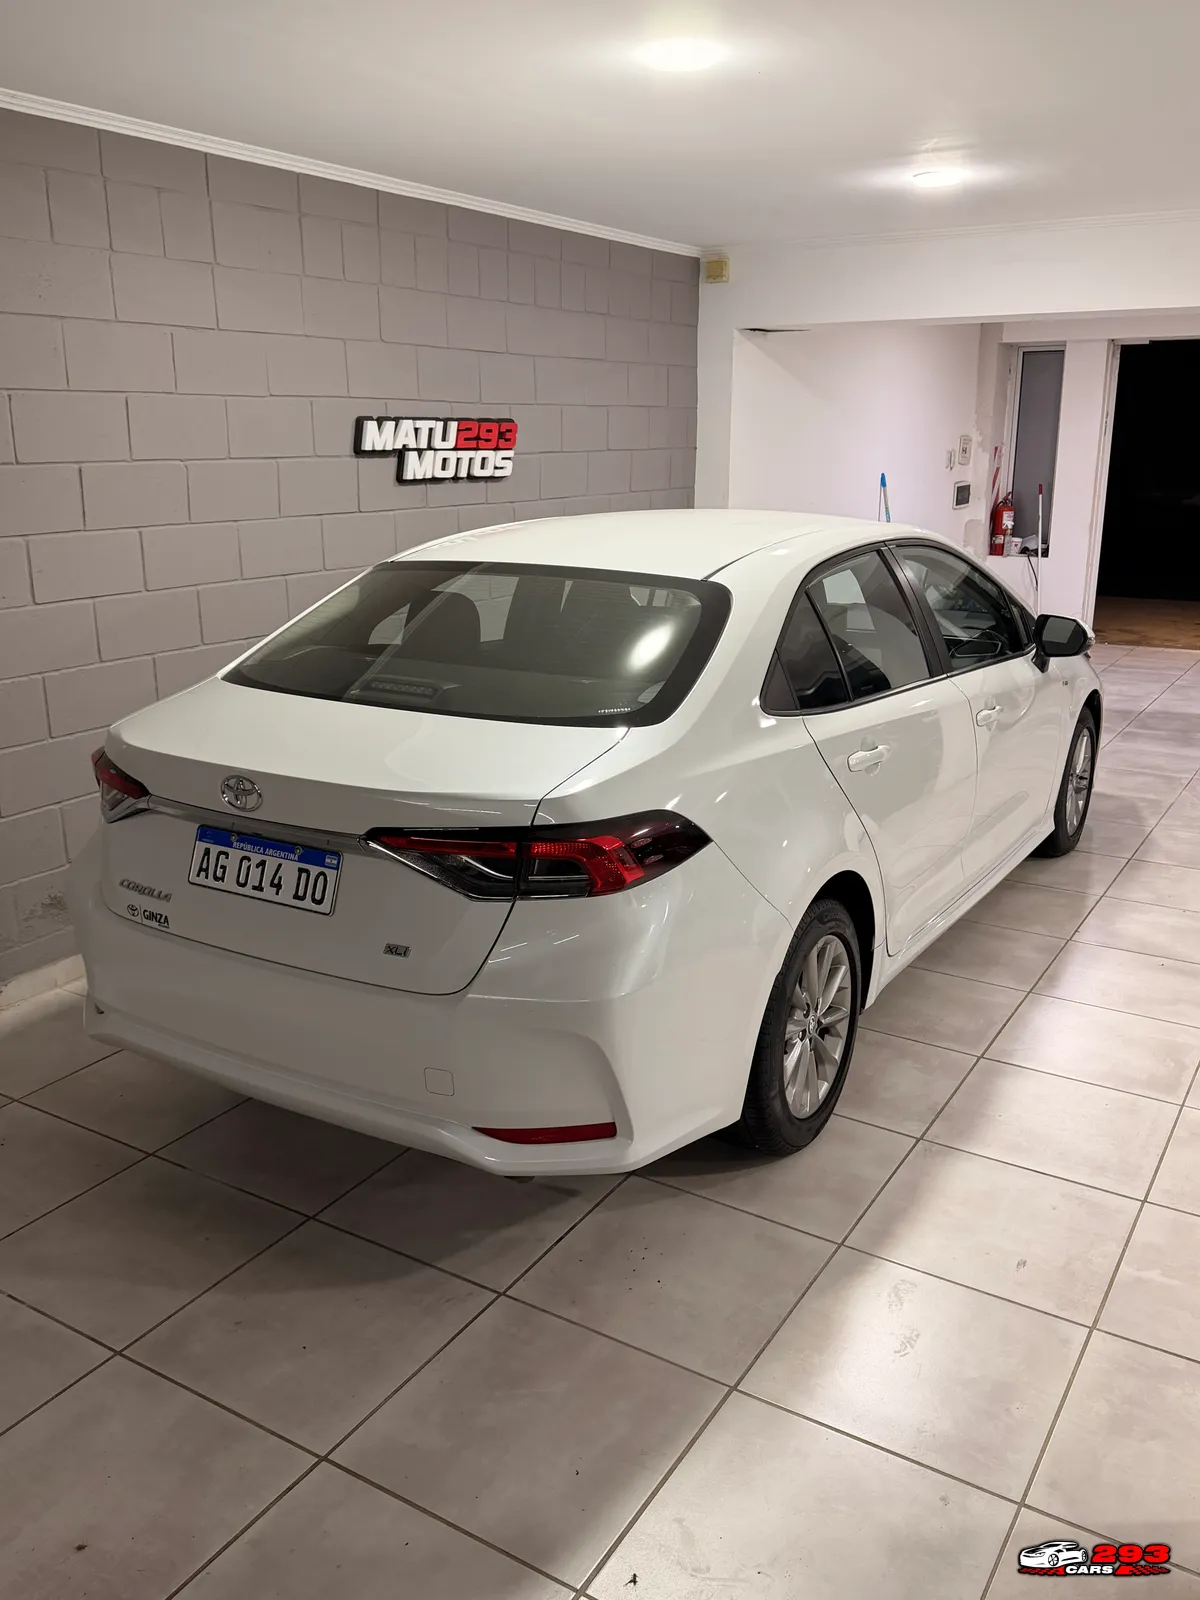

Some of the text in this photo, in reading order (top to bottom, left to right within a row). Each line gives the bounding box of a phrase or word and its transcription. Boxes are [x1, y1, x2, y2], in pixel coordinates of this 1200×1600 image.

[402, 450, 515, 480] MOTOS
[232, 840, 300, 862] REPÚBLICA ARGENTINA
[196, 847, 329, 906] AG 014 DO
[119, 878, 172, 903] COROLLA
[142, 909, 170, 926] GINZA
